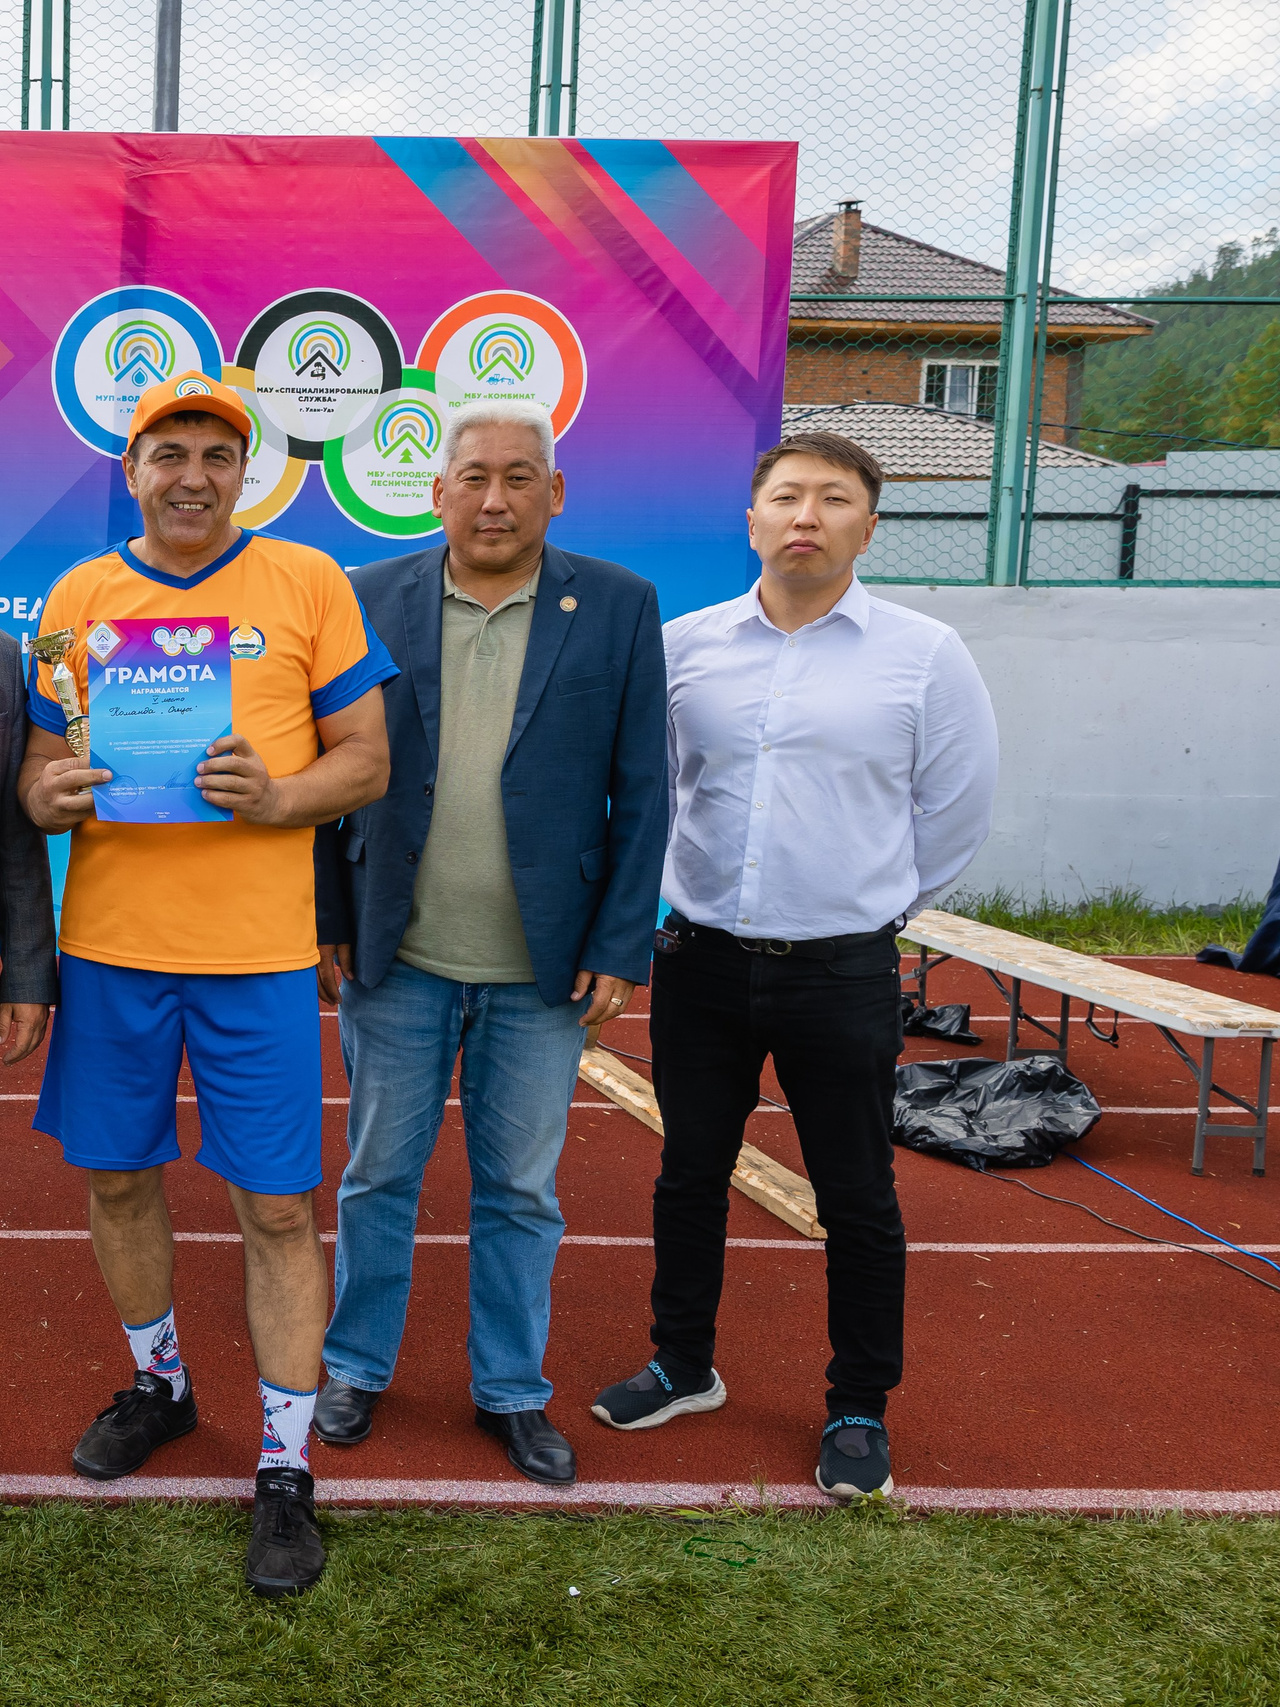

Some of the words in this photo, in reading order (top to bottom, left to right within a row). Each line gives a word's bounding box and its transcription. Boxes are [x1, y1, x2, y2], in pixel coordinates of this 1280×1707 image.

[275, 387, 379, 395] «СПЕЦИАЛИЗИРОВАННАЯ
[104, 664, 217, 684] ГРАМОТА
[131, 686, 190, 695] НАГРАЖДАЕТСЯ
[109, 706, 156, 717] Команда
